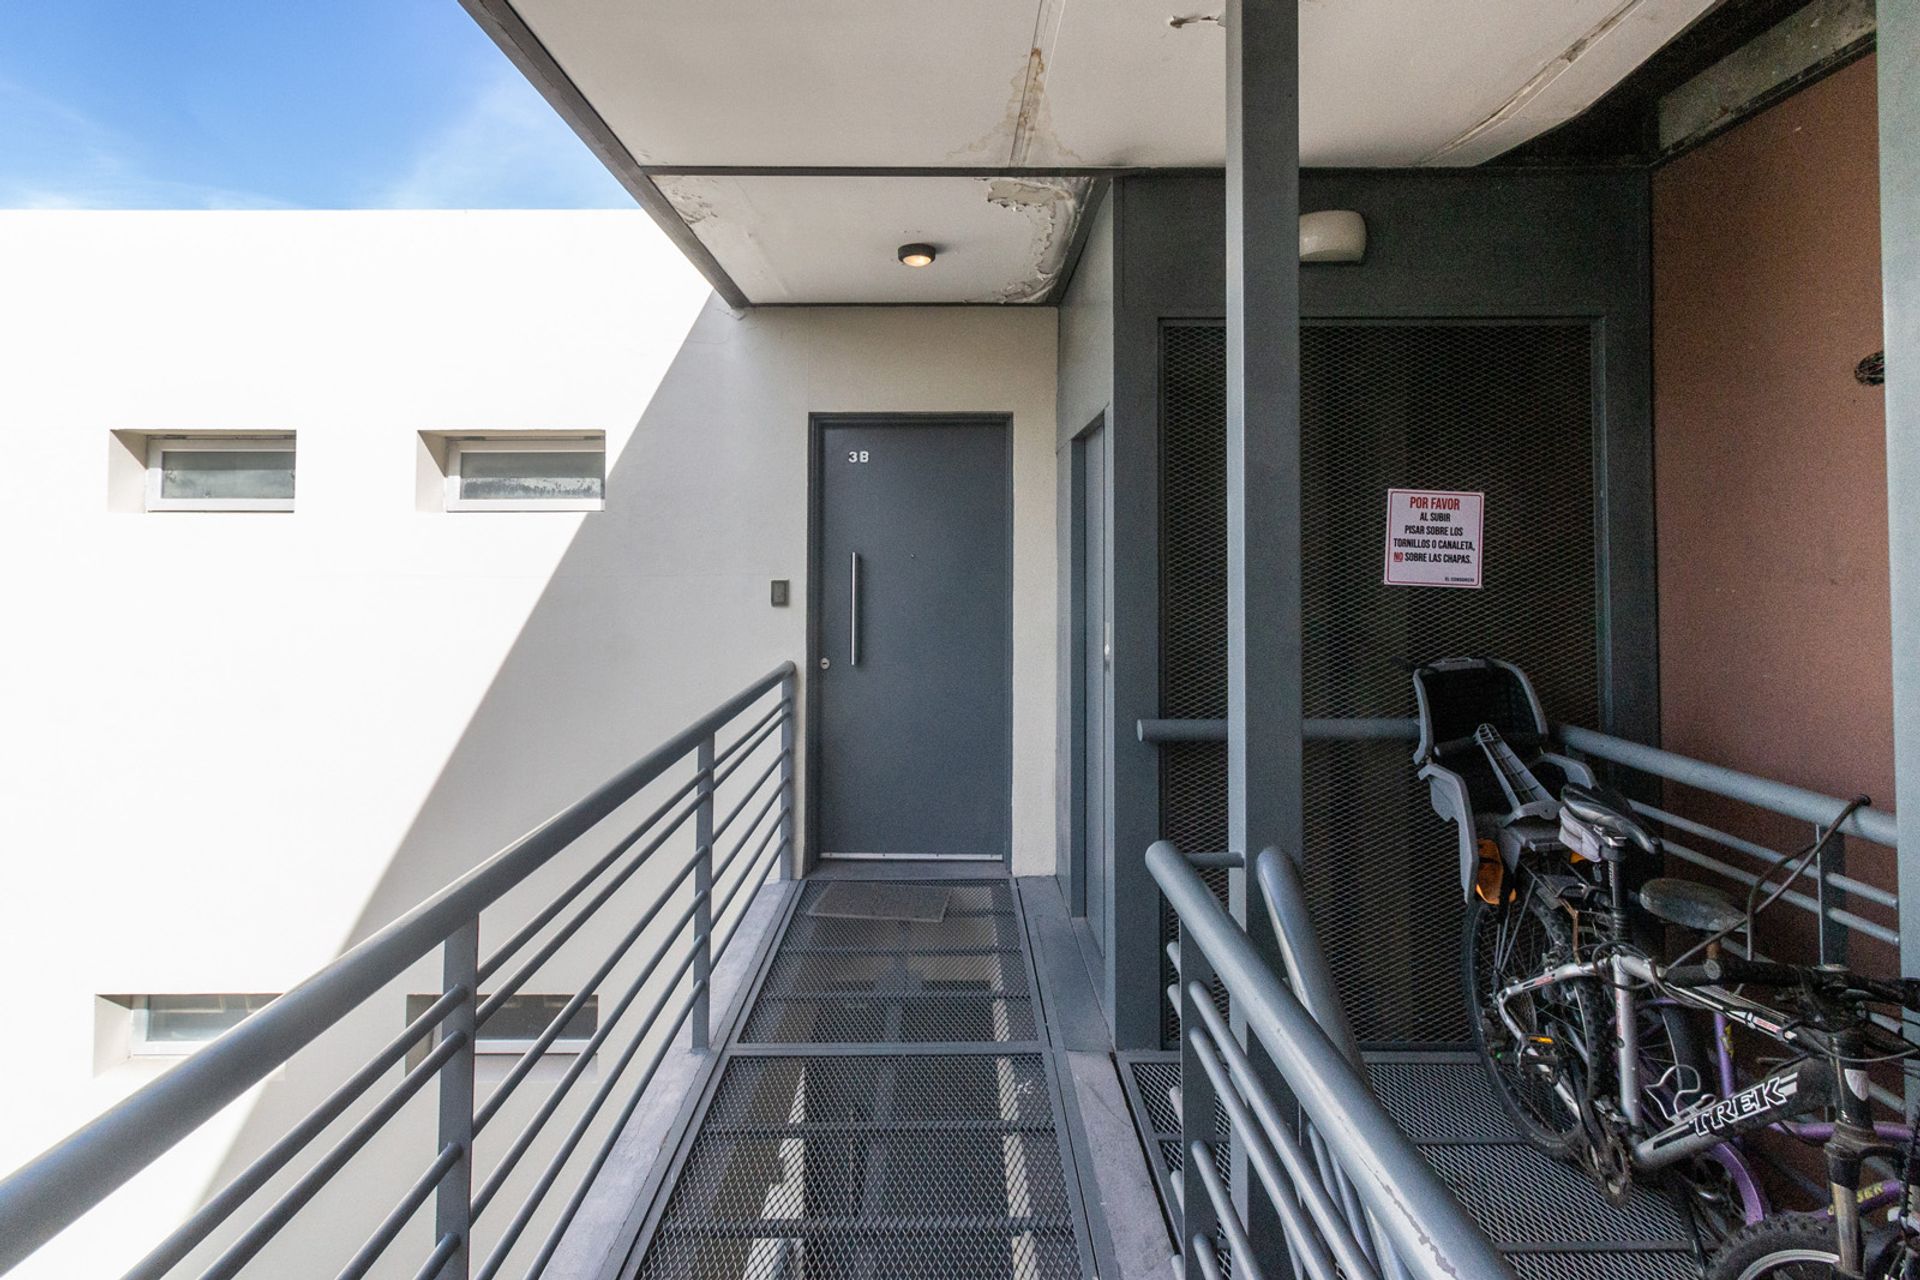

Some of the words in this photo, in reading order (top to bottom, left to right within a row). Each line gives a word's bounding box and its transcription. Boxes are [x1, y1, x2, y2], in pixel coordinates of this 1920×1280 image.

[848, 451, 869, 463] 3B
[1410, 496, 1428, 509] POR
[1431, 498, 1460, 510] FAVOR
[1420, 512, 1428, 521] AL
[1430, 512, 1450, 522] SUBIR
[1404, 525, 1424, 534] PISAR
[1426, 526, 1448, 535] SOBRE
[1450, 527, 1463, 536] LOS
[1393, 538, 1430, 548] TORNILLOS
[1432, 540, 1436, 549] O
[1438, 540, 1475, 551] CANALETA,
[1394, 552, 1403, 562] NO
[1405, 552, 1427, 562] SOBRE
[1429, 553, 1441, 562] LAS
[1443, 554, 1472, 564] CHAPAS.
[1689, 1077, 1787, 1136] TREK
